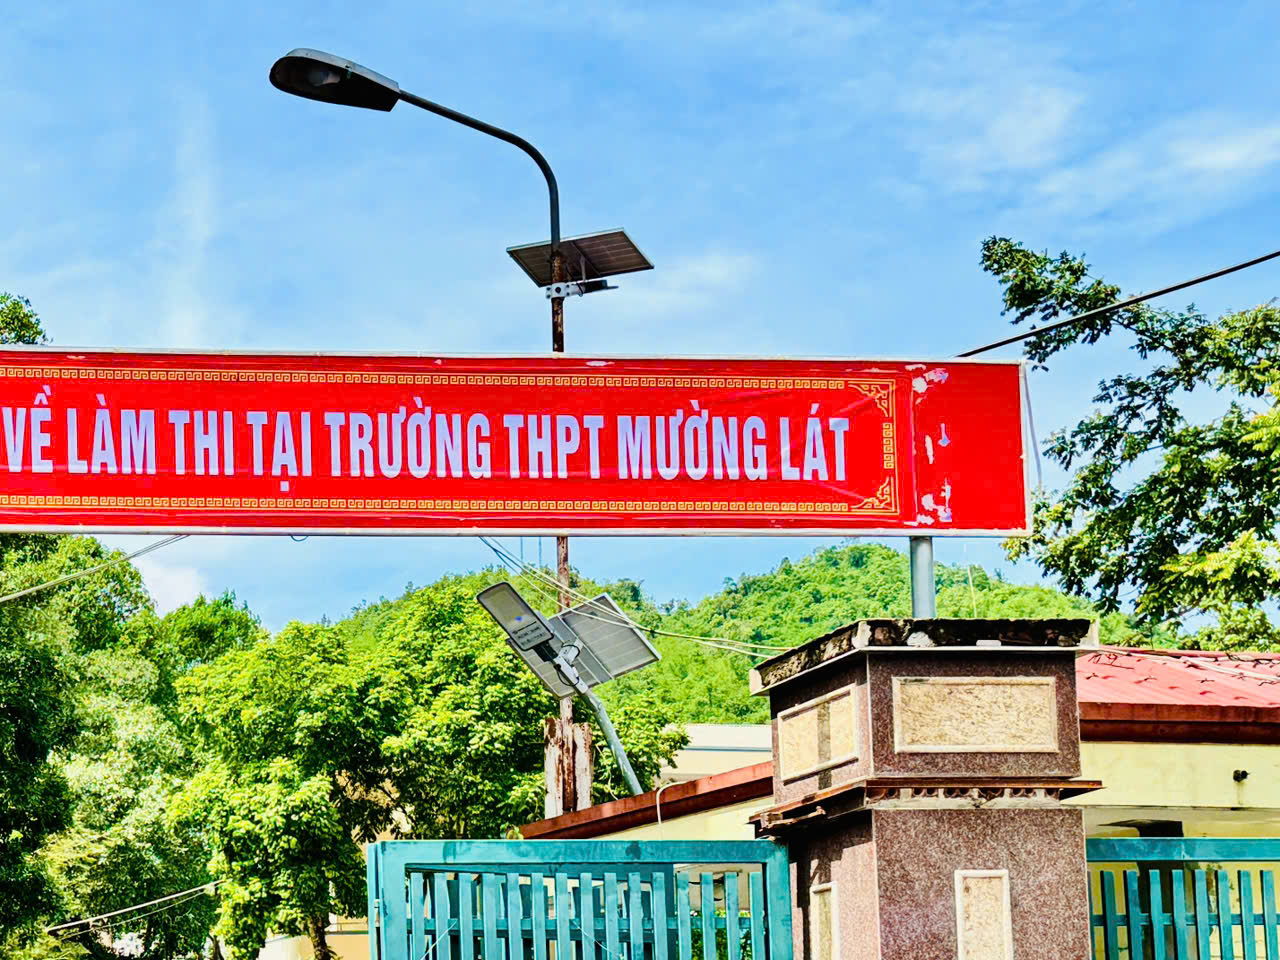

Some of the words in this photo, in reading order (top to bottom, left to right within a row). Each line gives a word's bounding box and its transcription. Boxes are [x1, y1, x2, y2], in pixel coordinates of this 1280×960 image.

[1, 384, 55, 473] VỀ
[66, 393, 157, 475] LÀM
[168, 409, 235, 476] THI
[246, 411, 313, 491] TẠI
[324, 397, 492, 479] TRƯỜNG
[503, 414, 604, 480] THPT
[617, 400, 768, 481] MƯỜNG
[779, 403, 850, 482] LÁT
